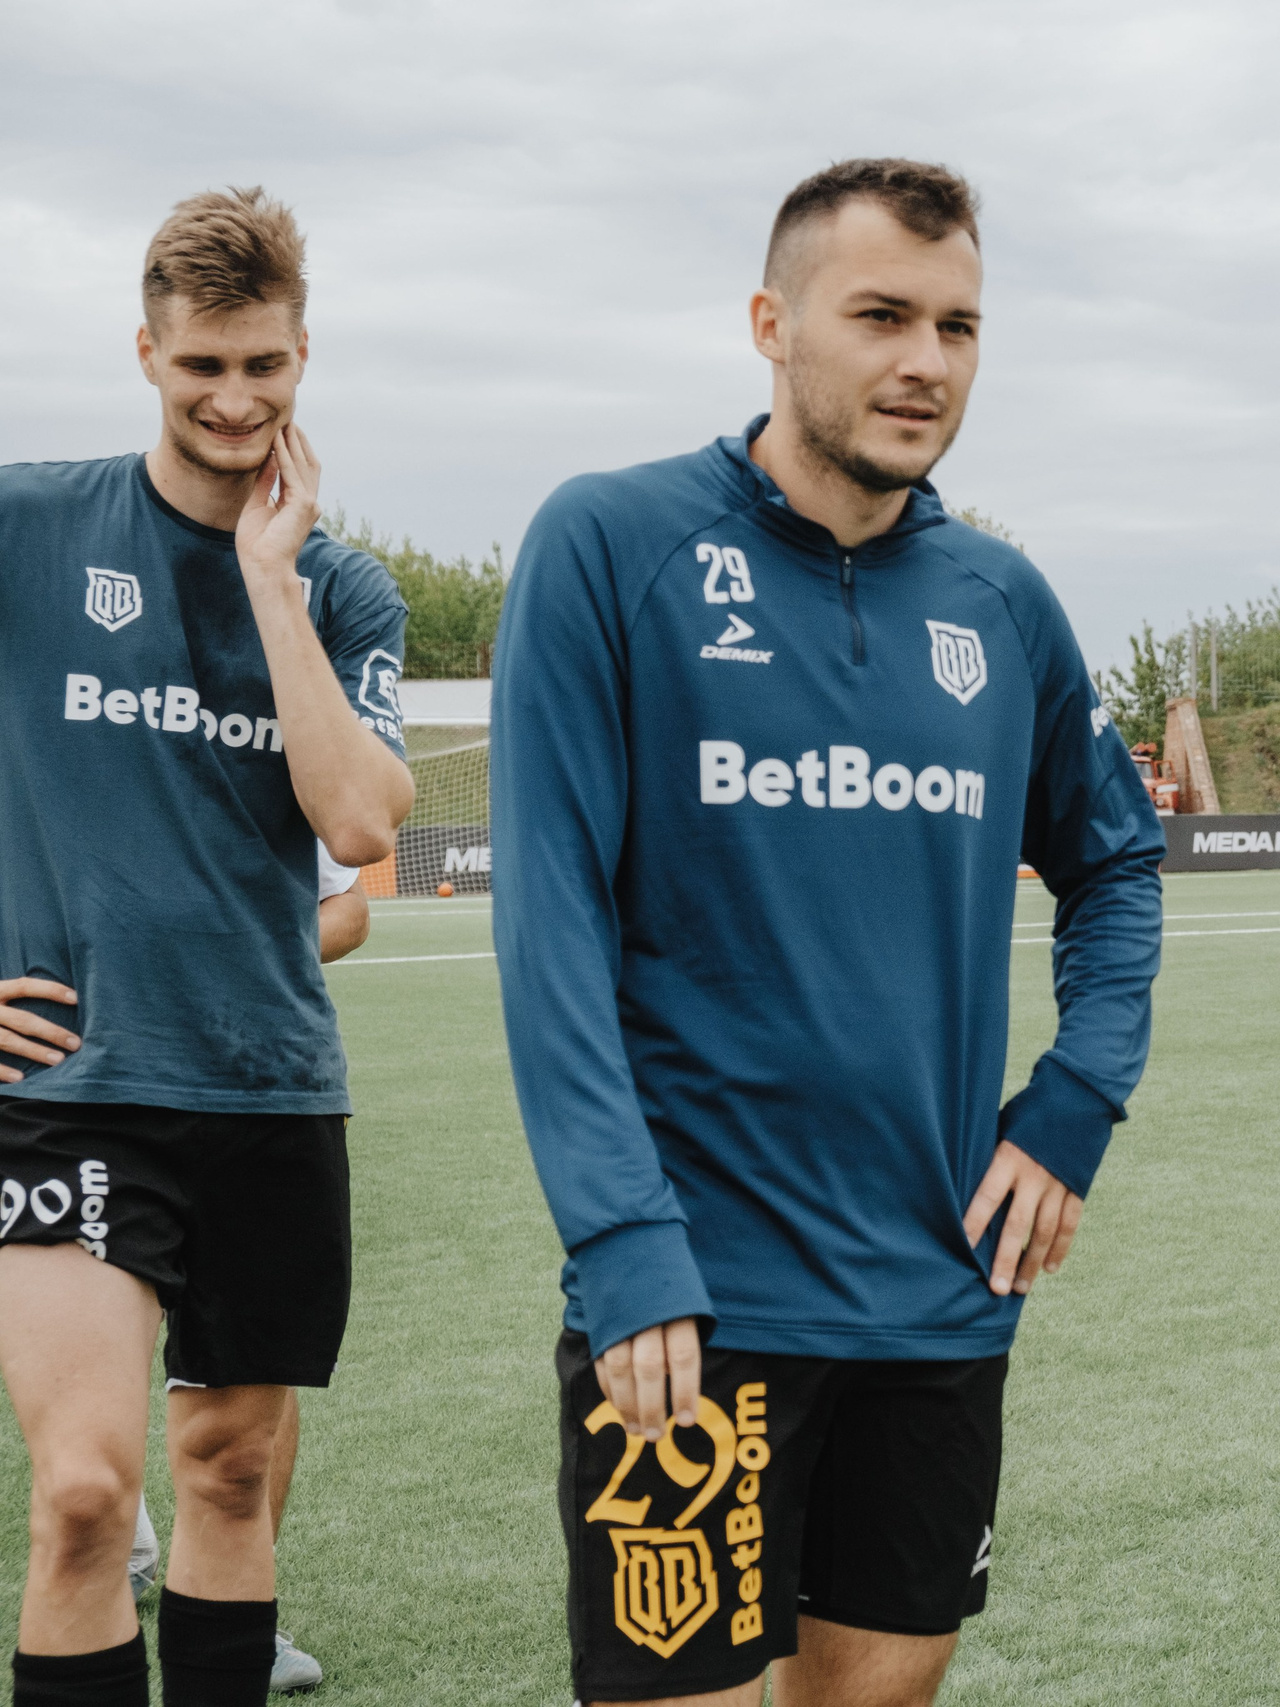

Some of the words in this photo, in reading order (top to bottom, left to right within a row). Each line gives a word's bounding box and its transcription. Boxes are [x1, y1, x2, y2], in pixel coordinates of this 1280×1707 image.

[696, 542, 755, 604] 29
[699, 645, 775, 664] DEMIX
[699, 740, 985, 820] BetBoom
[1192, 831, 1274, 853] MEDIA
[0, 1179, 72, 1239] 90
[584, 1395, 737, 1530] 29
[726, 1382, 771, 1646] BetBoom
